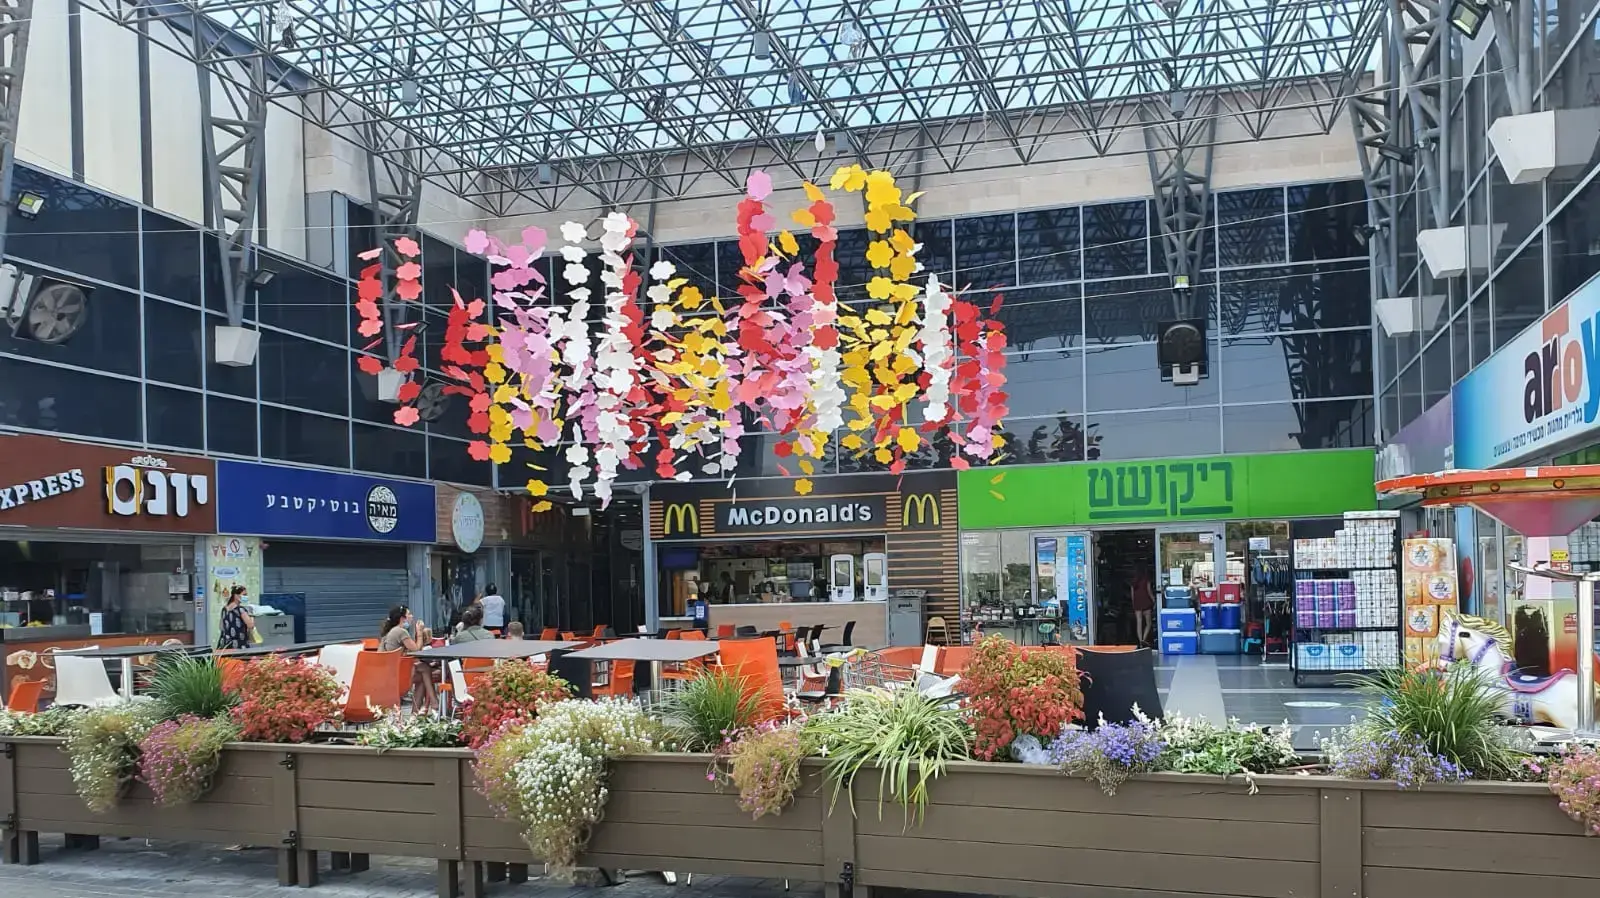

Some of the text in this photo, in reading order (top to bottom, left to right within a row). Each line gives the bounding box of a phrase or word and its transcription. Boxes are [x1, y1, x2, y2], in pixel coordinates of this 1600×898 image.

[0, 468, 85, 510] XPRESS
[1087, 462, 1234, 516] ריקושט
[369, 503, 397, 518] מאיה
[728, 503, 872, 526] McDonald's
